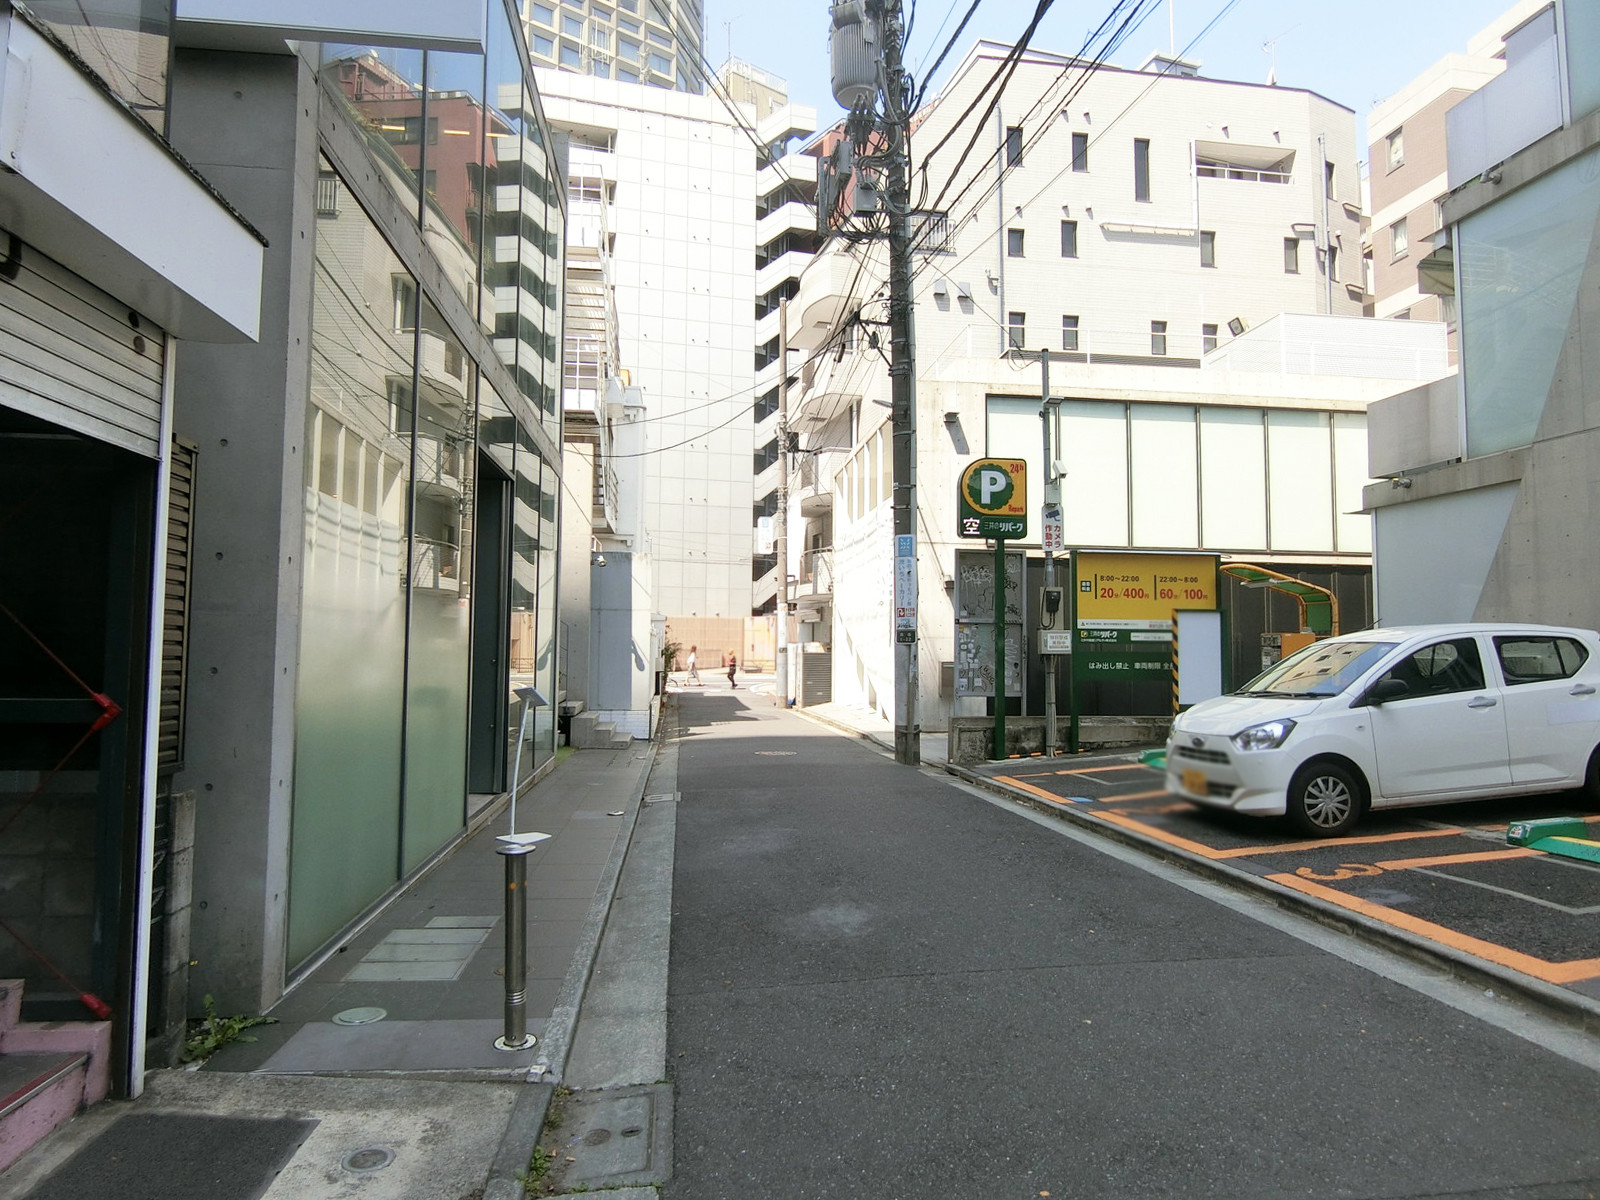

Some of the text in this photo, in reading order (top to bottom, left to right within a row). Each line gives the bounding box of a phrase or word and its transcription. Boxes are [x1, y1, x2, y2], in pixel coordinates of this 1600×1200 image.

[1009, 463, 1024, 474] 24h
[981, 470, 1007, 504] P
[963, 517, 980, 535] 空
[984, 521, 1024, 533] 三井のリパーク
[1045, 524, 1053, 548] 作動中
[1053, 525, 1061, 548] カメラ
[1088, 661, 1130, 670] はみ出し禁止
